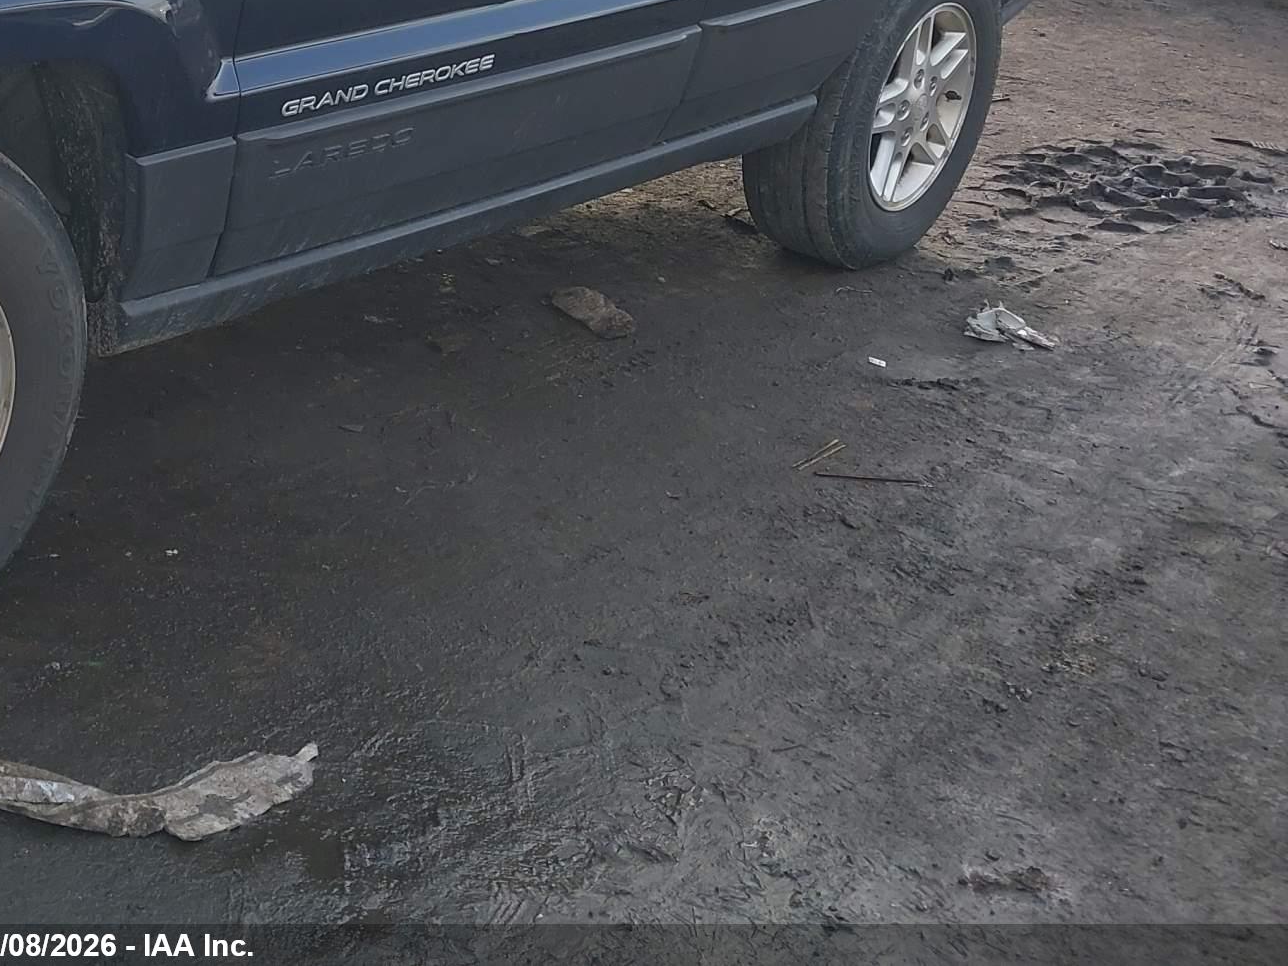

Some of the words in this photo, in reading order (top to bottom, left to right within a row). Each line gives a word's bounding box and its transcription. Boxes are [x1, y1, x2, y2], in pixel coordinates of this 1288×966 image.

[280, 82, 369, 118] GRAND
[374, 53, 496, 96] CHEROKEE
[268, 126, 415, 180] LAREDO
